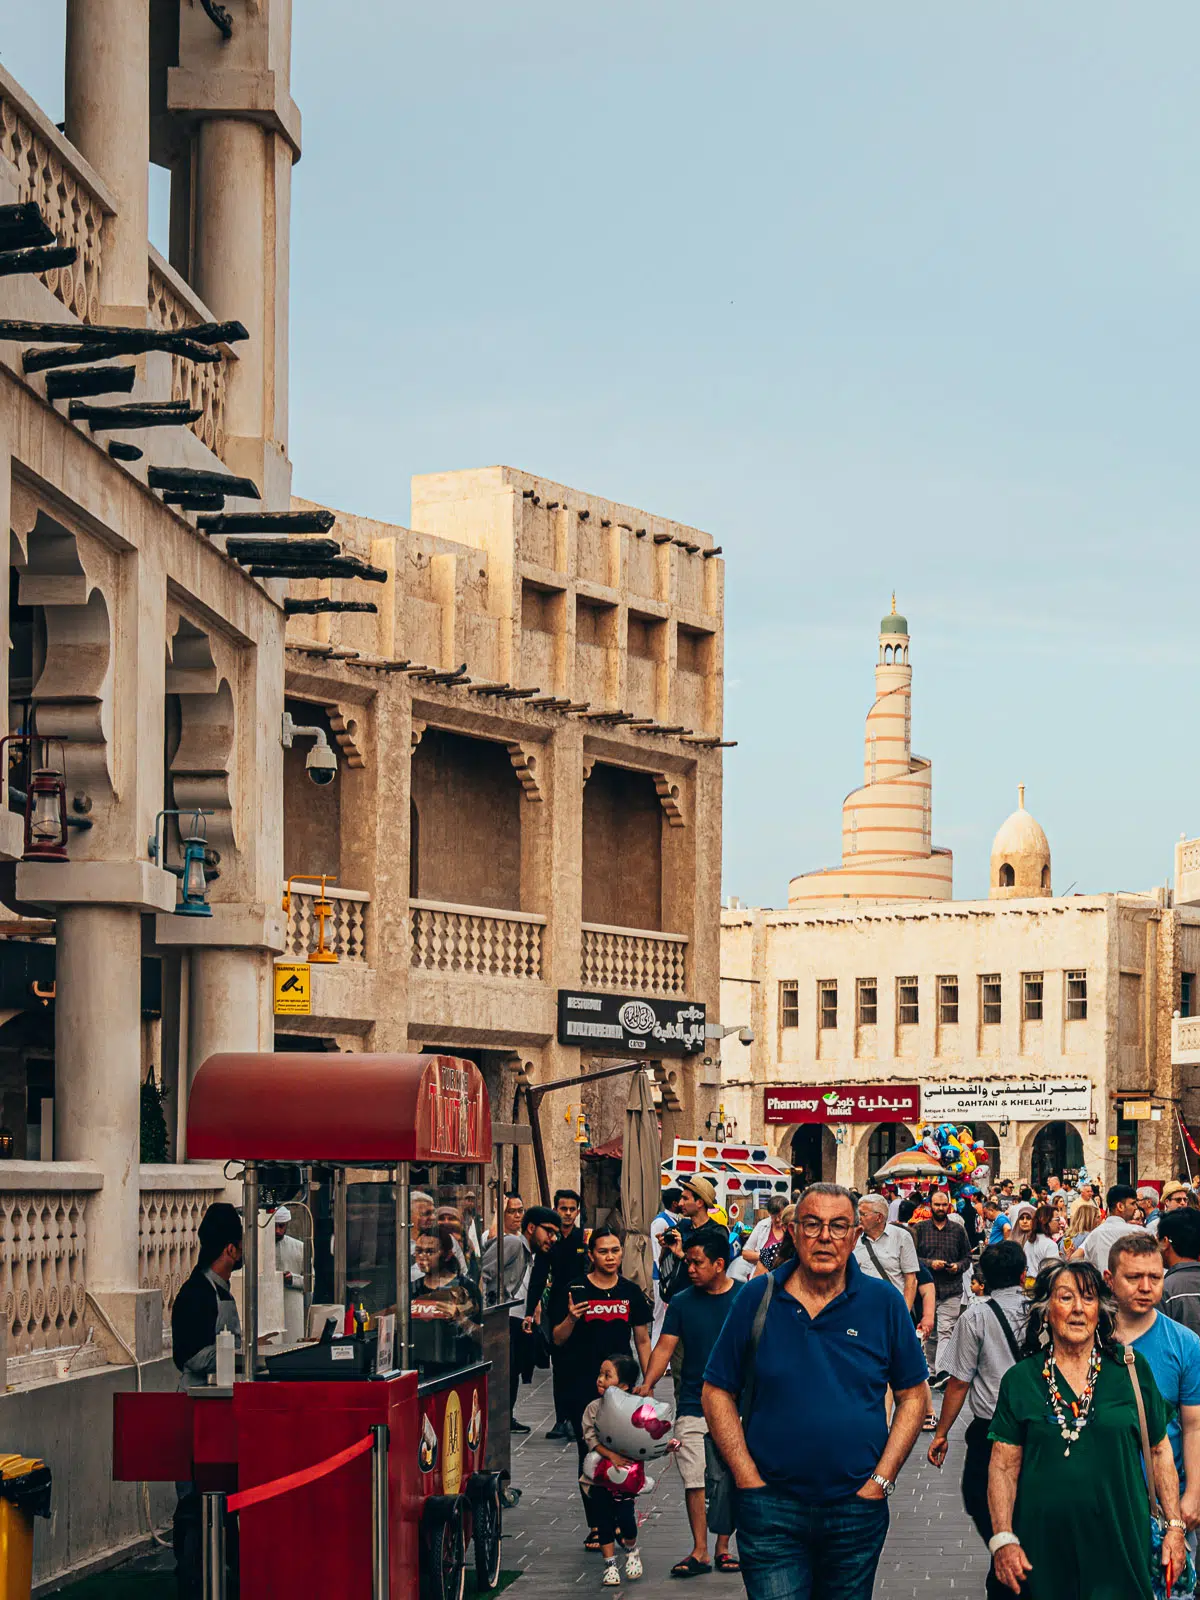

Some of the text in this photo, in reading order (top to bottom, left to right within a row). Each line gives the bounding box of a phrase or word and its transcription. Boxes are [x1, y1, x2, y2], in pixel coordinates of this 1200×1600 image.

[924, 1083, 1087, 1100] متجر الخليفي والقحطاني
[767, 1097, 818, 1112] Pharmacy
[826, 1106, 852, 1116] Kulud
[858, 1095, 912, 1112] صيدلية
